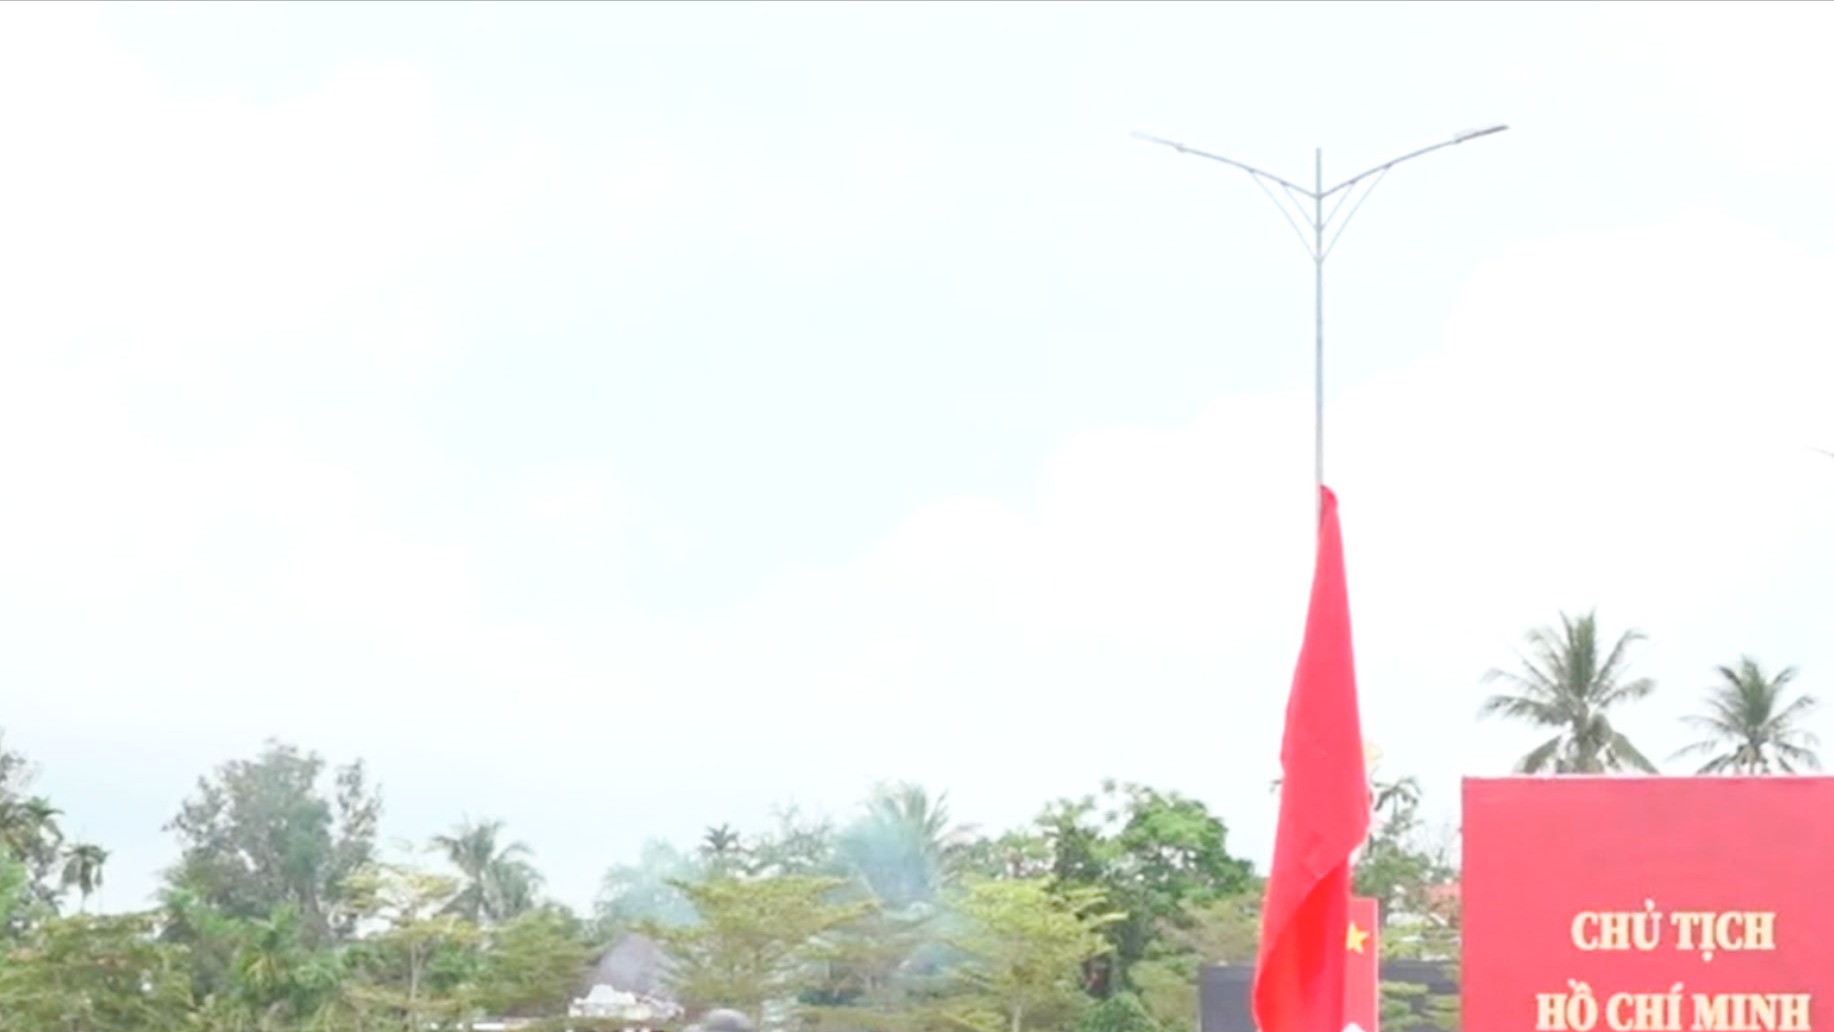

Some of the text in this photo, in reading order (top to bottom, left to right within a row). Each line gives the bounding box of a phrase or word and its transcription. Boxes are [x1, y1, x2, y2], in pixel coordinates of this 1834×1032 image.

[1571, 899, 1776, 962] CHỦ TỊCH
[1535, 979, 1812, 1032] HỒ CHÍ MINH
